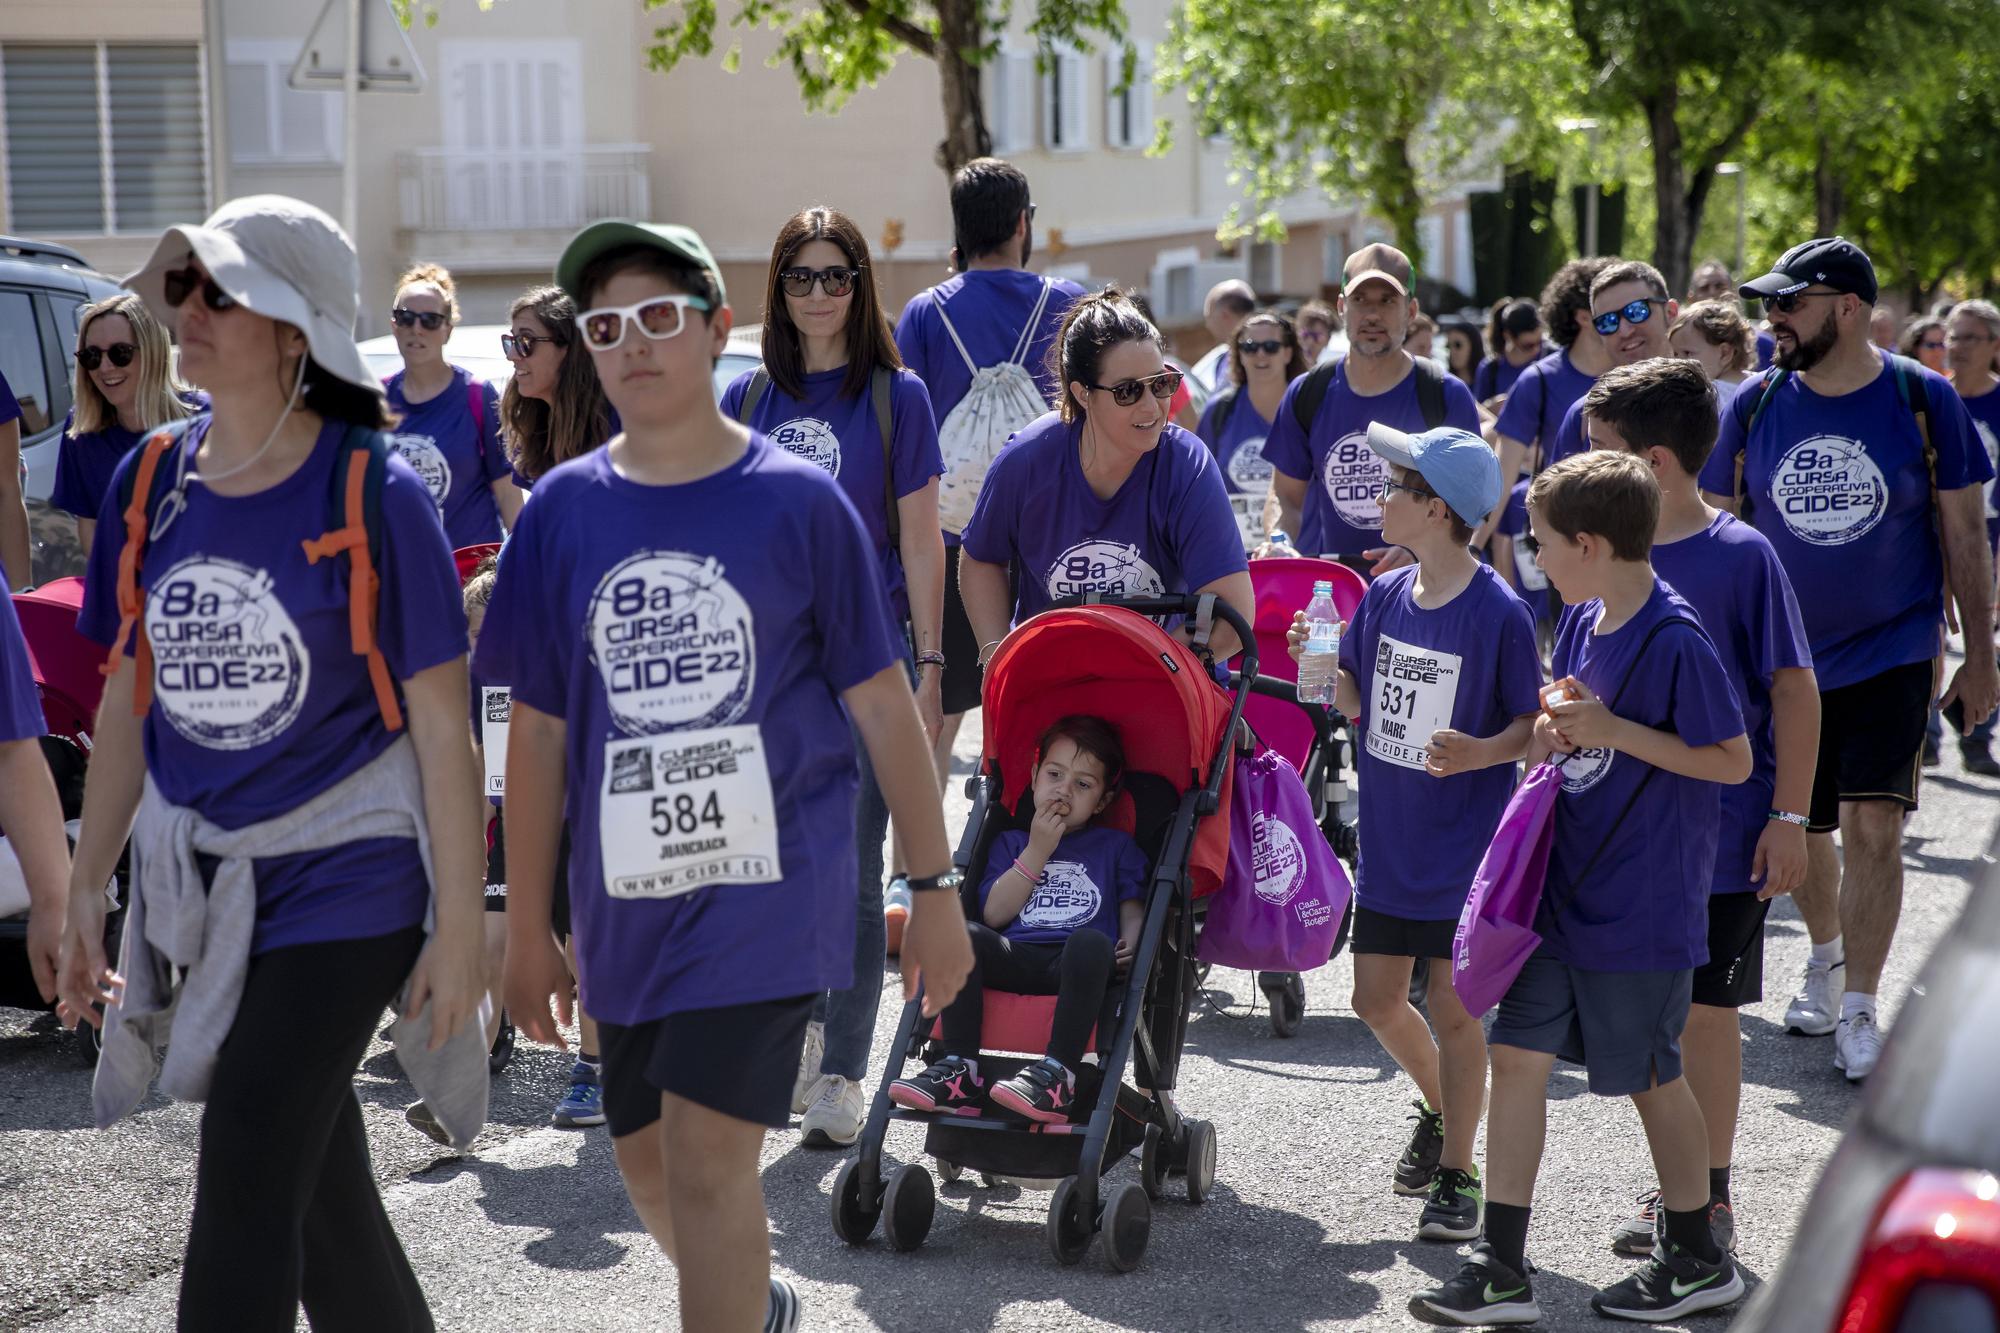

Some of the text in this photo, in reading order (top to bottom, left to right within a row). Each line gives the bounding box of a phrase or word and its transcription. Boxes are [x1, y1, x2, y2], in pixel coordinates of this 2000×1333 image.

[777, 428, 805, 444] 8a
[1339, 444, 1370, 463] 8a
[1793, 448, 1832, 470] 8a
[1332, 464, 1382, 477] CURSA
[1783, 471, 1848, 486] CURSA
[1329, 476, 1384, 485] COOPERAT
[1778, 482, 1871, 496] COOPERATIVA
[1335, 484, 1383, 501] CIDE
[1065, 556, 1106, 581] 8a
[1056, 580, 1125, 594] CURSA
[161, 581, 220, 618] 8a
[613, 577, 672, 617] 8a
[151, 621, 243, 643] CURSA
[605, 612, 698, 644] CURSA
[1392, 660, 1454, 675] COOPERATIVA
[1394, 653, 1438, 667] CURSA
[1393, 667, 1438, 684] CIDE
[1380, 681, 1417, 719] 531
[1381, 718, 1407, 740] MARC
[659, 738, 732, 764] CURSA
[664, 755, 738, 785] CIDE
[651, 789, 725, 836] 584
[1298, 898, 1321, 910] Cash
[1301, 904, 1332, 919] &Carry
